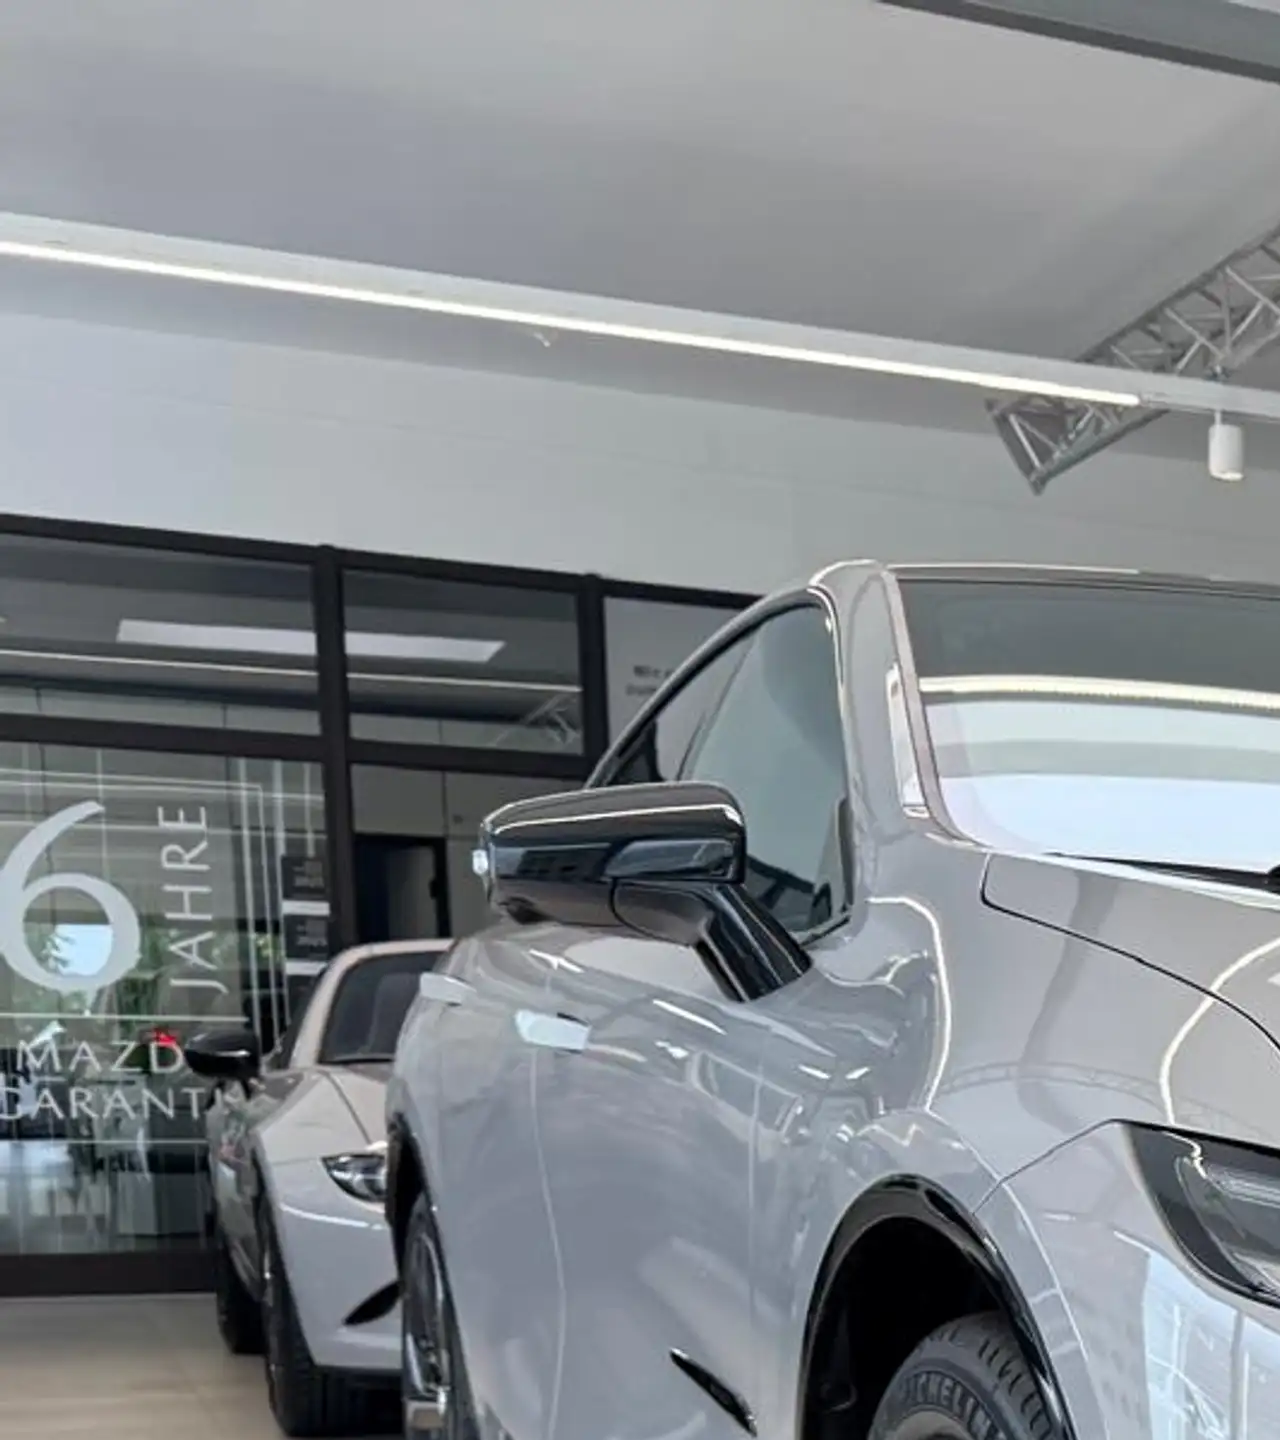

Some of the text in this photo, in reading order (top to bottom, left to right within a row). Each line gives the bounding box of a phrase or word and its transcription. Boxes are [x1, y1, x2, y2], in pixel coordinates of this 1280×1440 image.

[0, 801, 142, 994] 6
[158, 806, 228, 994] JAHRE
[16, 1040, 185, 1073] MAZD
